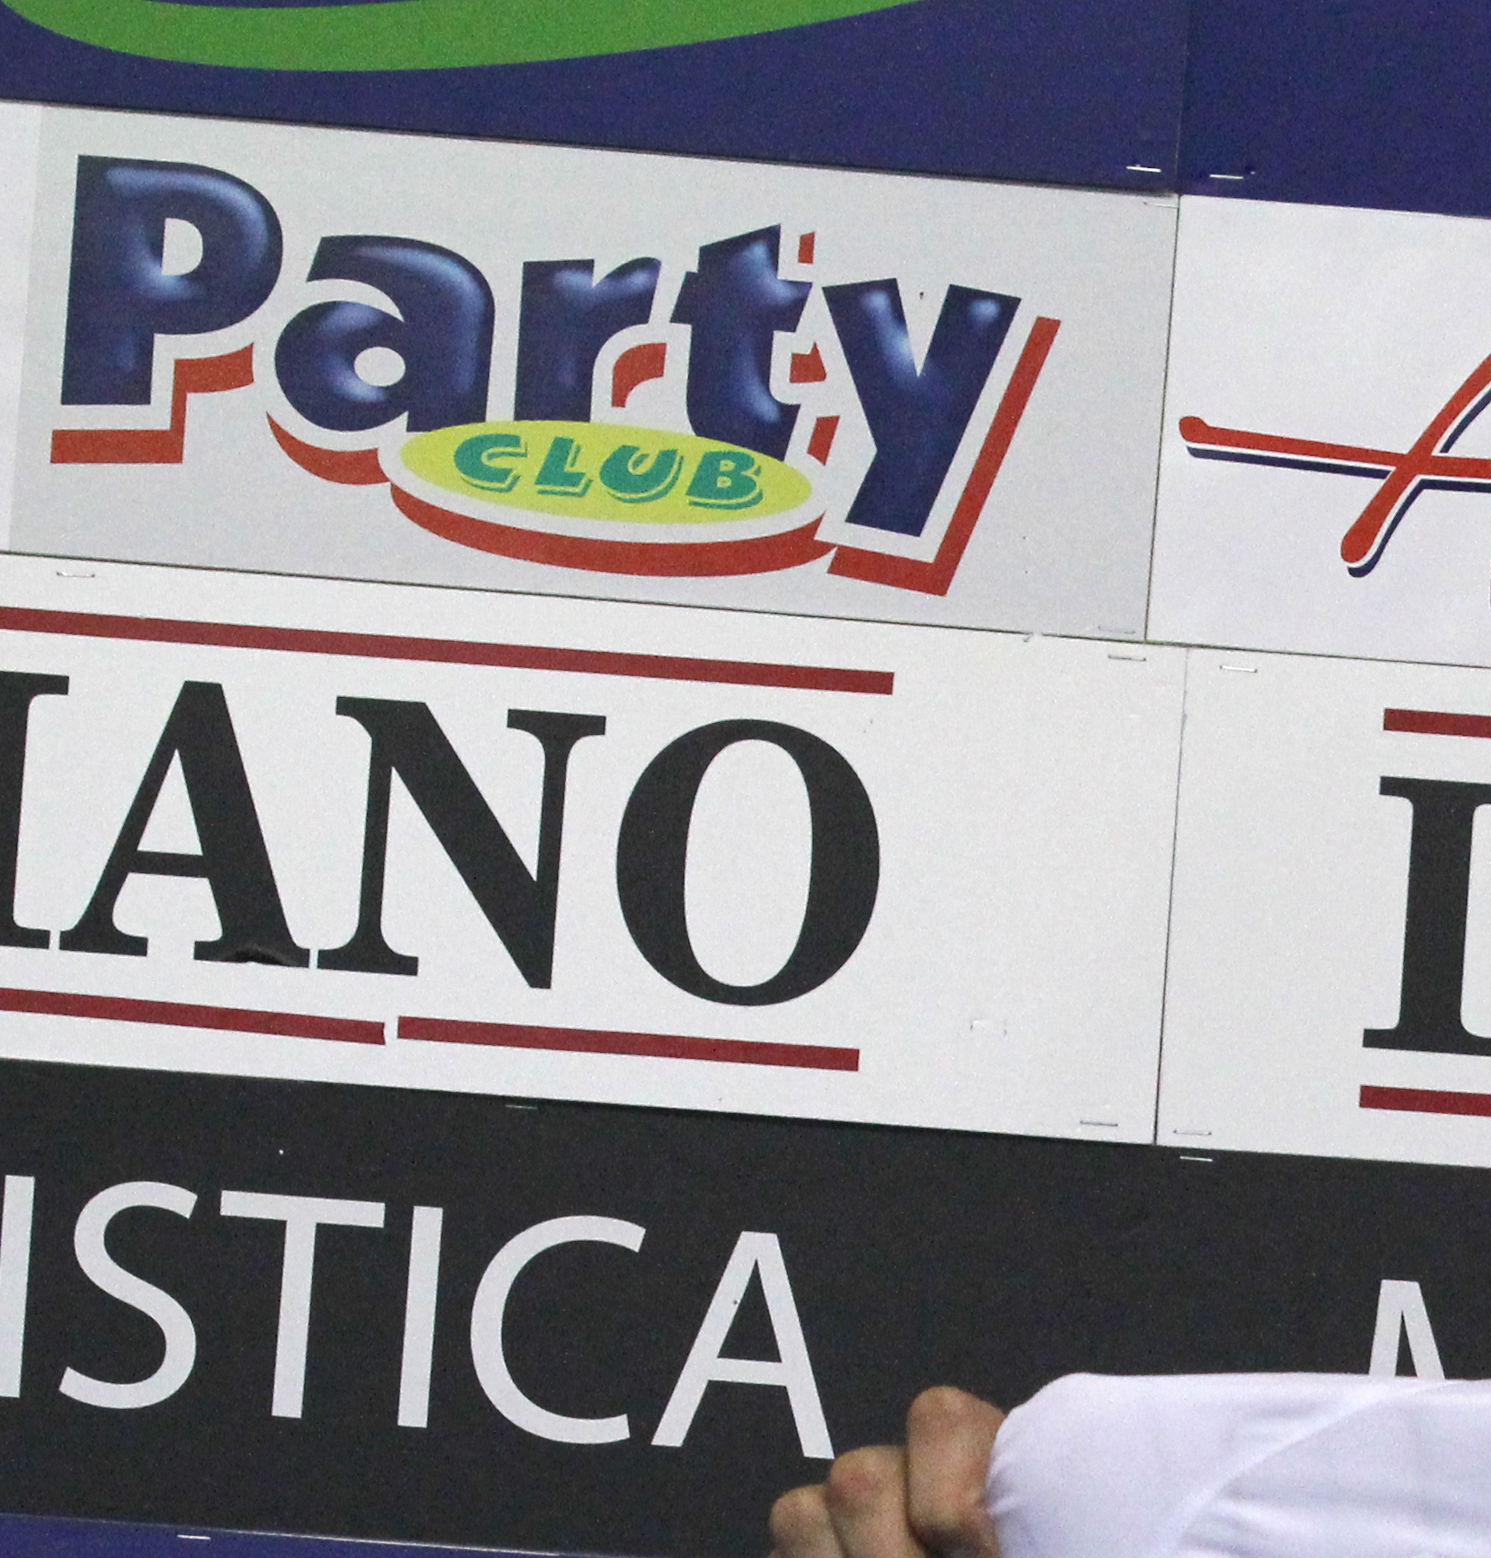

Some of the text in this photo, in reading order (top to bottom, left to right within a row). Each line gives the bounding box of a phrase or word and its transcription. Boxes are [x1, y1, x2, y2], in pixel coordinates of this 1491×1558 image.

[52, 154, 1061, 596] Party
[452, 432, 766, 510] CLUB
[0, 1174, 836, 1460] ISTICA
